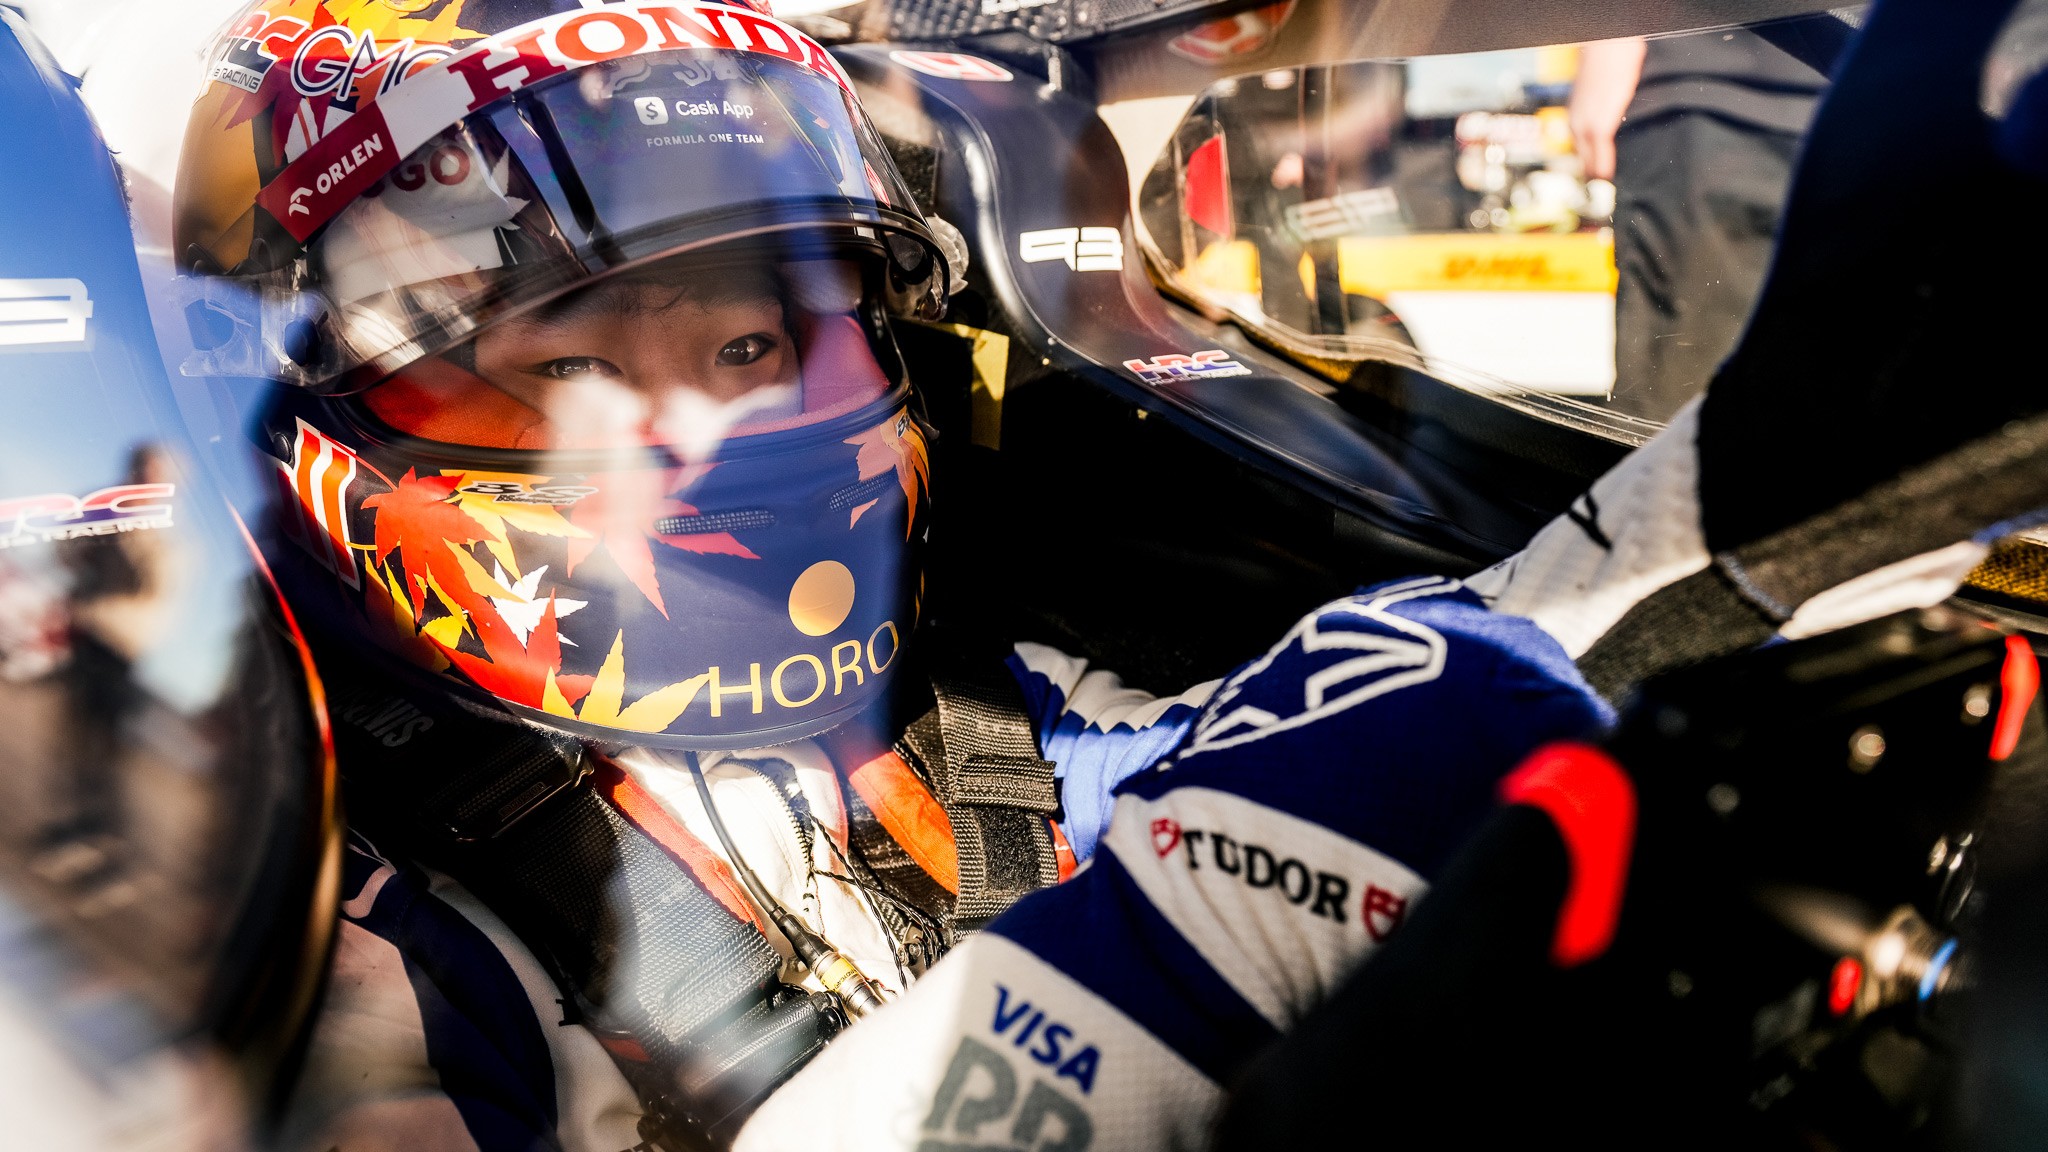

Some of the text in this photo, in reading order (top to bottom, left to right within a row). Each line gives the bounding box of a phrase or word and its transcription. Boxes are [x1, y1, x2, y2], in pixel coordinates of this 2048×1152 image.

[446, 6, 856, 112] HONDA
[646, 133, 765, 148] FORMULA ONE TEAM
[675, 101, 719, 117] Cash
[723, 101, 754, 118] App
[316, 133, 384, 195] ORLEN
[708, 620, 899, 719] HORO
[1182, 828, 1349, 925] TUDOR
[992, 984, 1101, 1095] VISA
